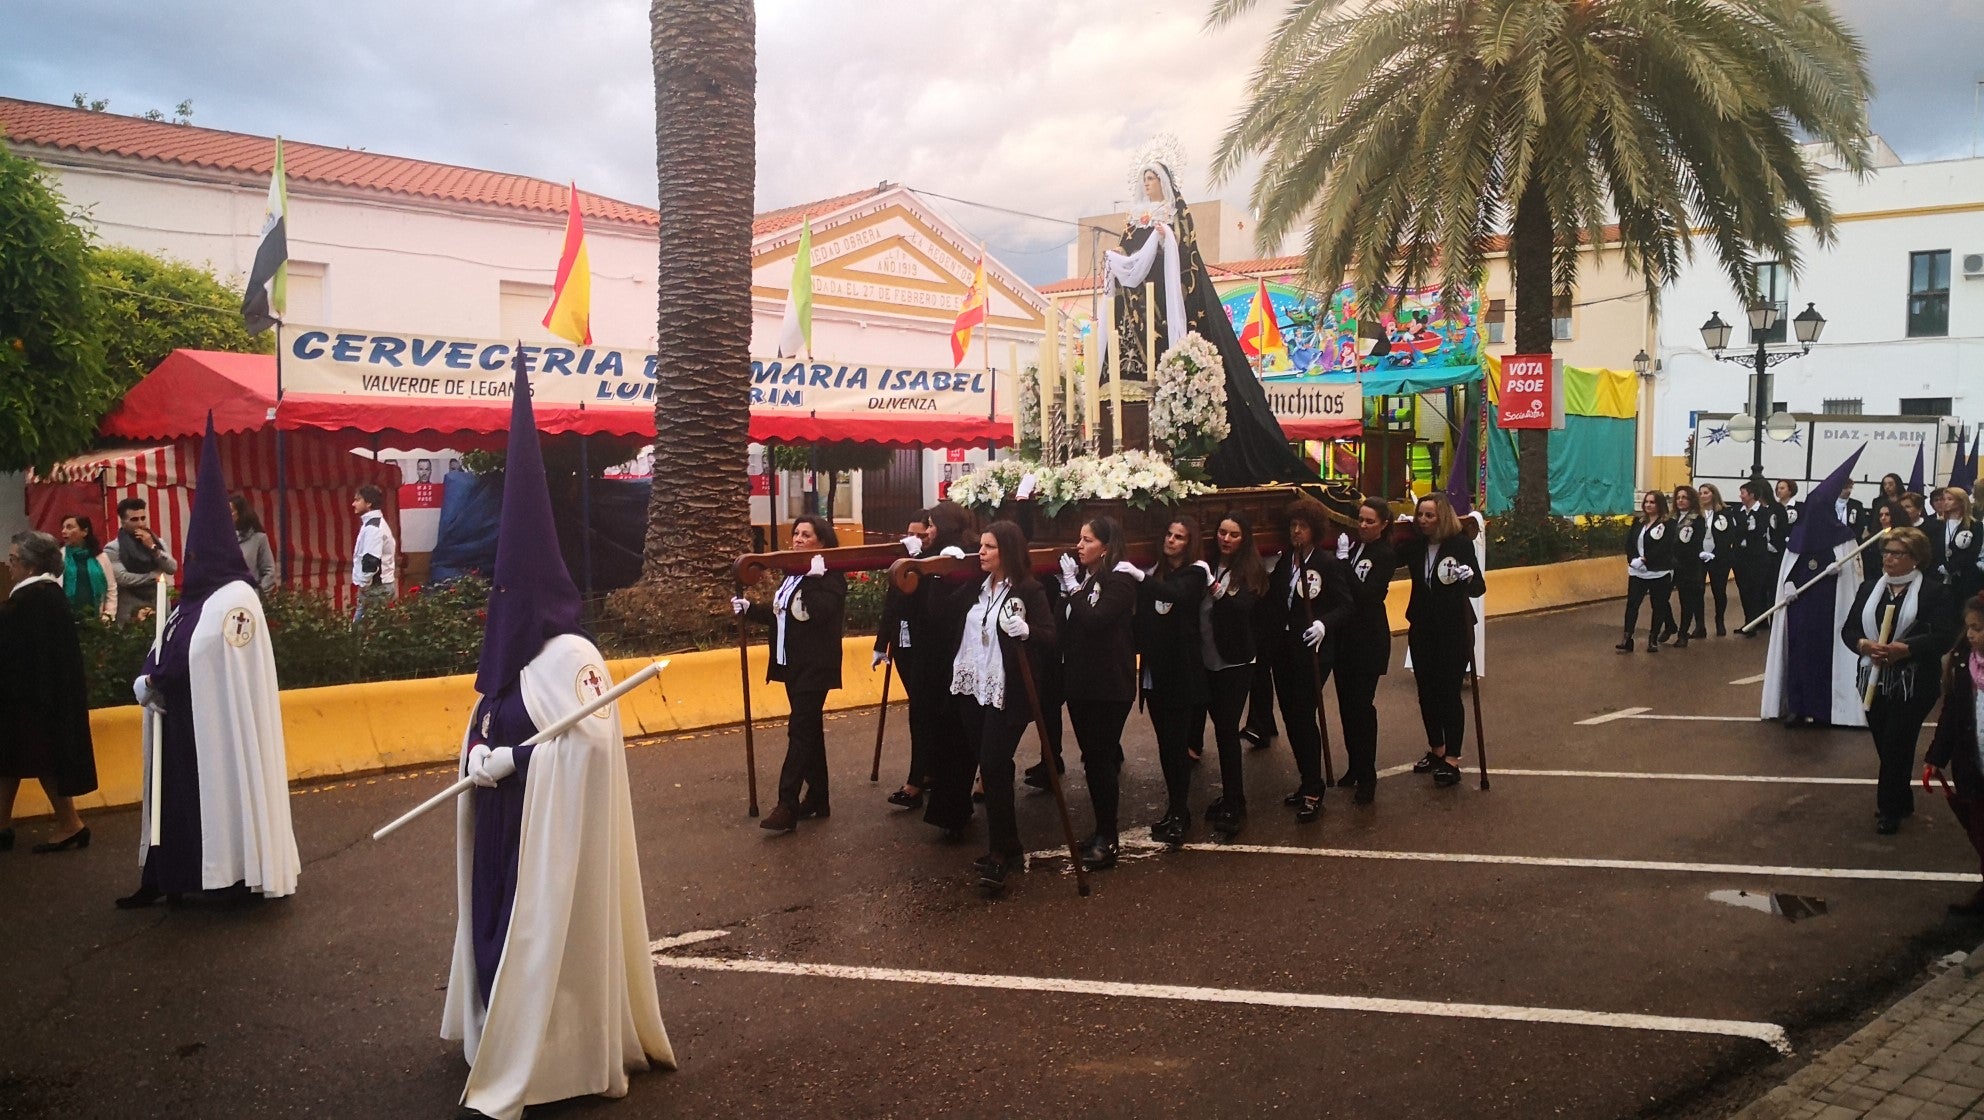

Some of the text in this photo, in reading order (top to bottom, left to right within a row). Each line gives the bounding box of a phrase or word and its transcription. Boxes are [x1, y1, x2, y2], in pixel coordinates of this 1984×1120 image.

[844, 228, 881, 250] OBRERA
[899, 262, 917, 276] 1919
[927, 243, 973, 284] REDENTOR
[846, 282, 859, 296] EL
[863, 285, 874, 298] 27
[878, 287, 891, 300] DE
[894, 289, 937, 306] FEBRERO
[940, 295, 951, 308] DE
[293, 331, 623, 377] CERVECERIA
[750, 360, 986, 393] MARIA ISABEL
[1508, 362, 1543, 376] VOTA
[362, 374, 535, 397] VALVERDE DE LEGANS
[1506, 379, 1544, 393] PSOE
[868, 397, 937, 411] OLIVENZA
[1267, 386, 1345, 419] inchitos
[1824, 429, 1860, 440] DIAZ
[1874, 430, 1926, 442] MARIN
